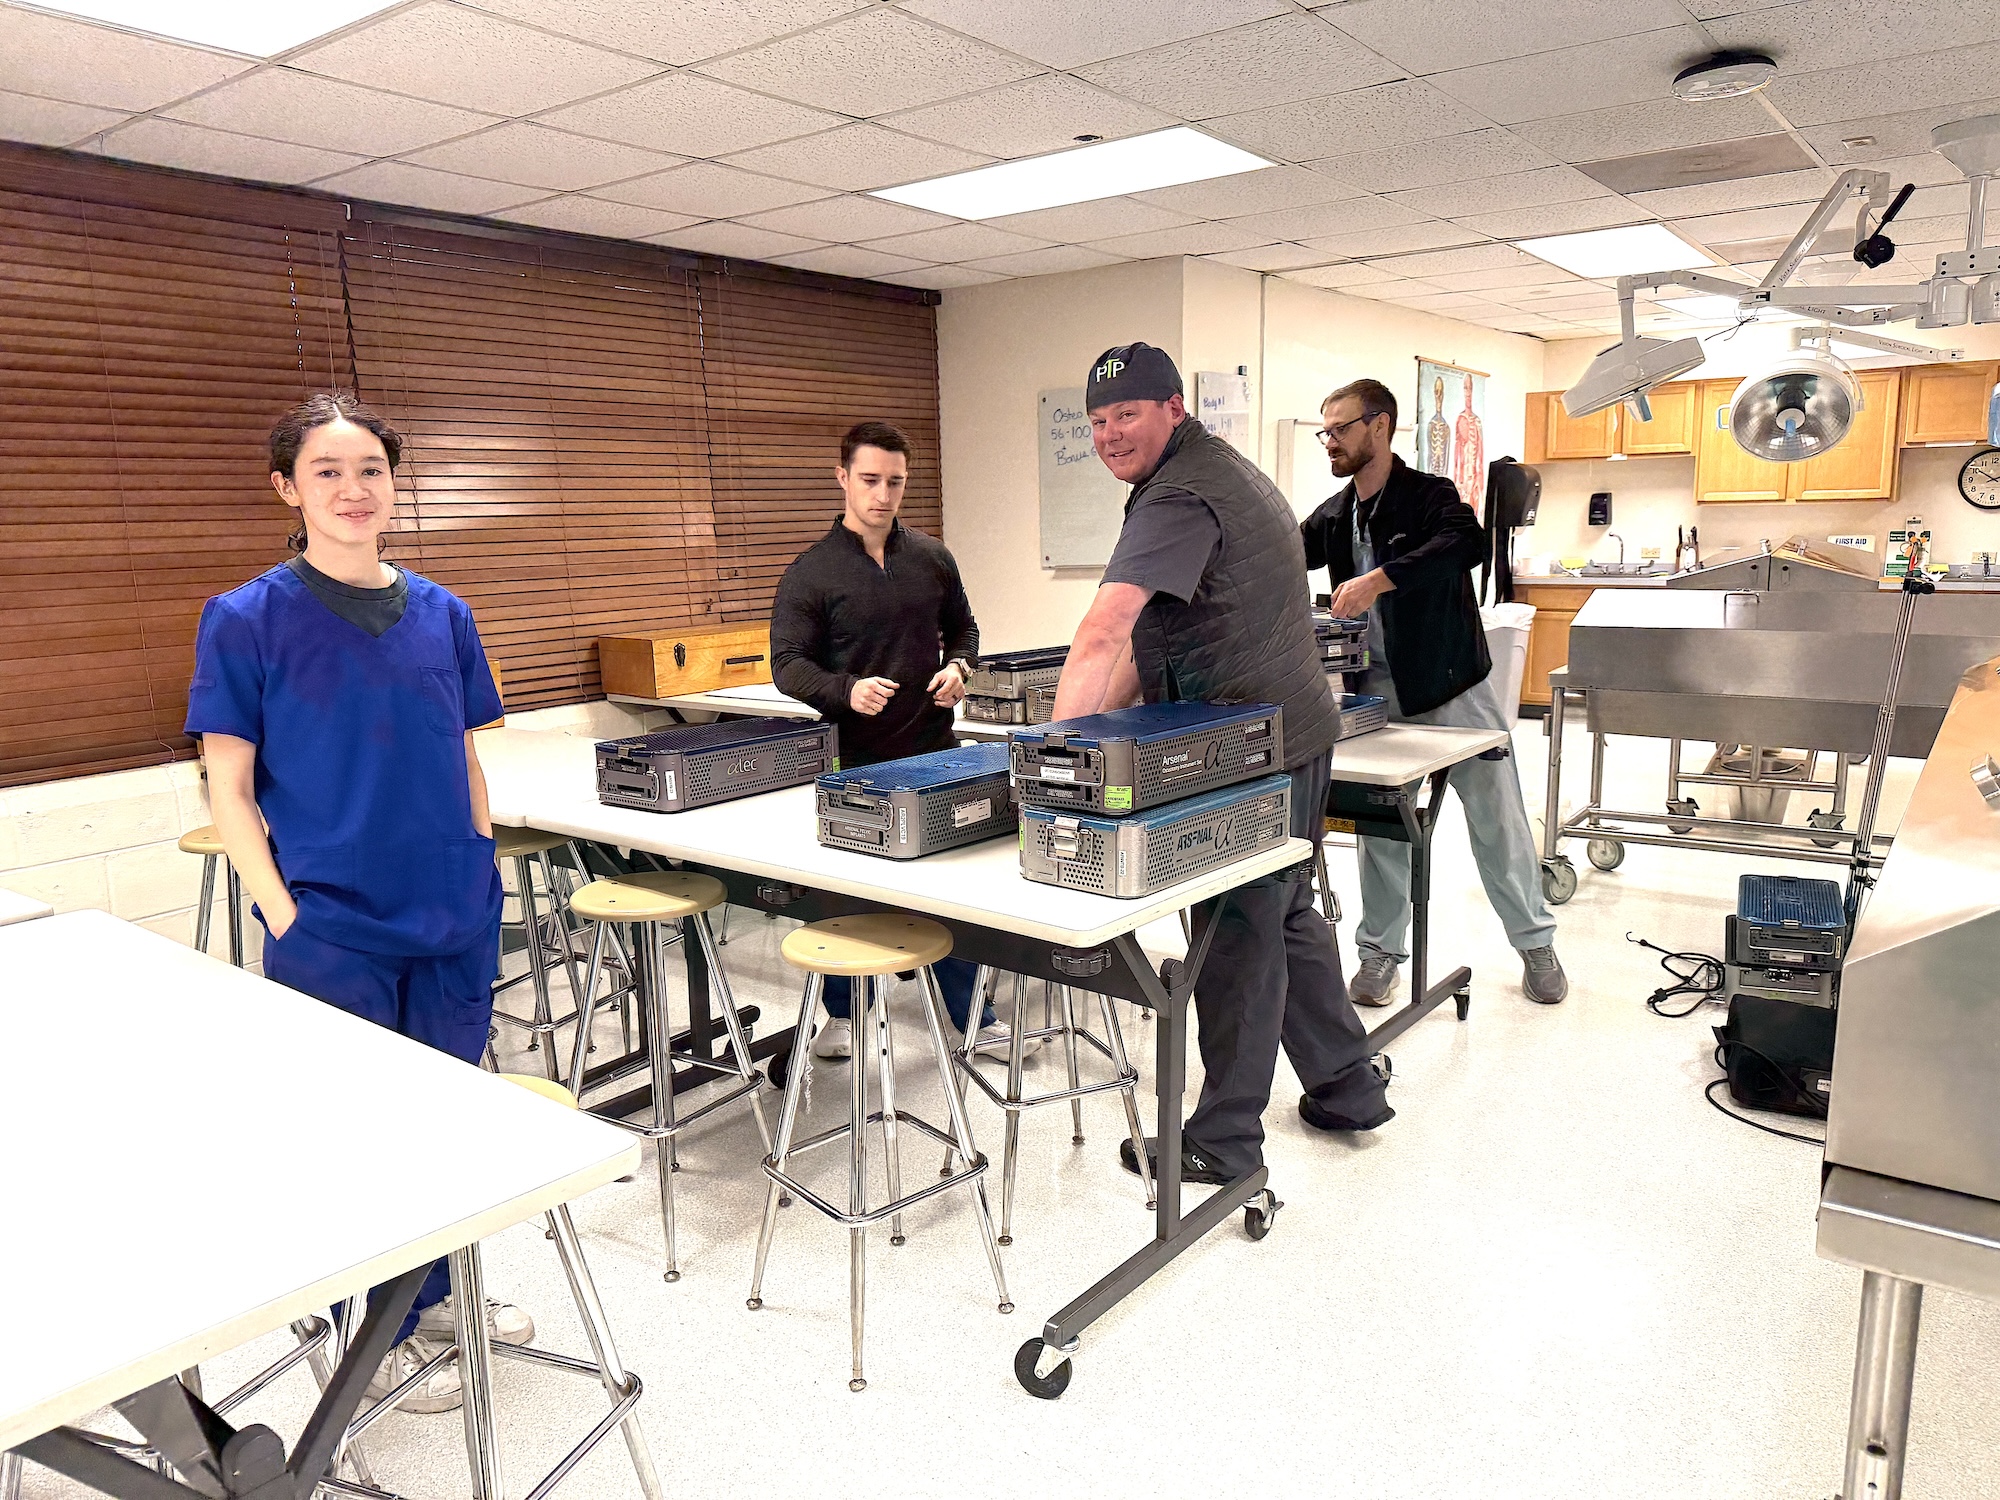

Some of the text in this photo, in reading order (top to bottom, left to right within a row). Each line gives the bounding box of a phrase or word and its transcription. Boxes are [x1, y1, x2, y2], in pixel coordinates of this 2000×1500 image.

[1096, 358, 1125, 383] PTP
[1053, 408, 1083, 423] Osteo
[1162, 750, 1189, 767] Arsenal
